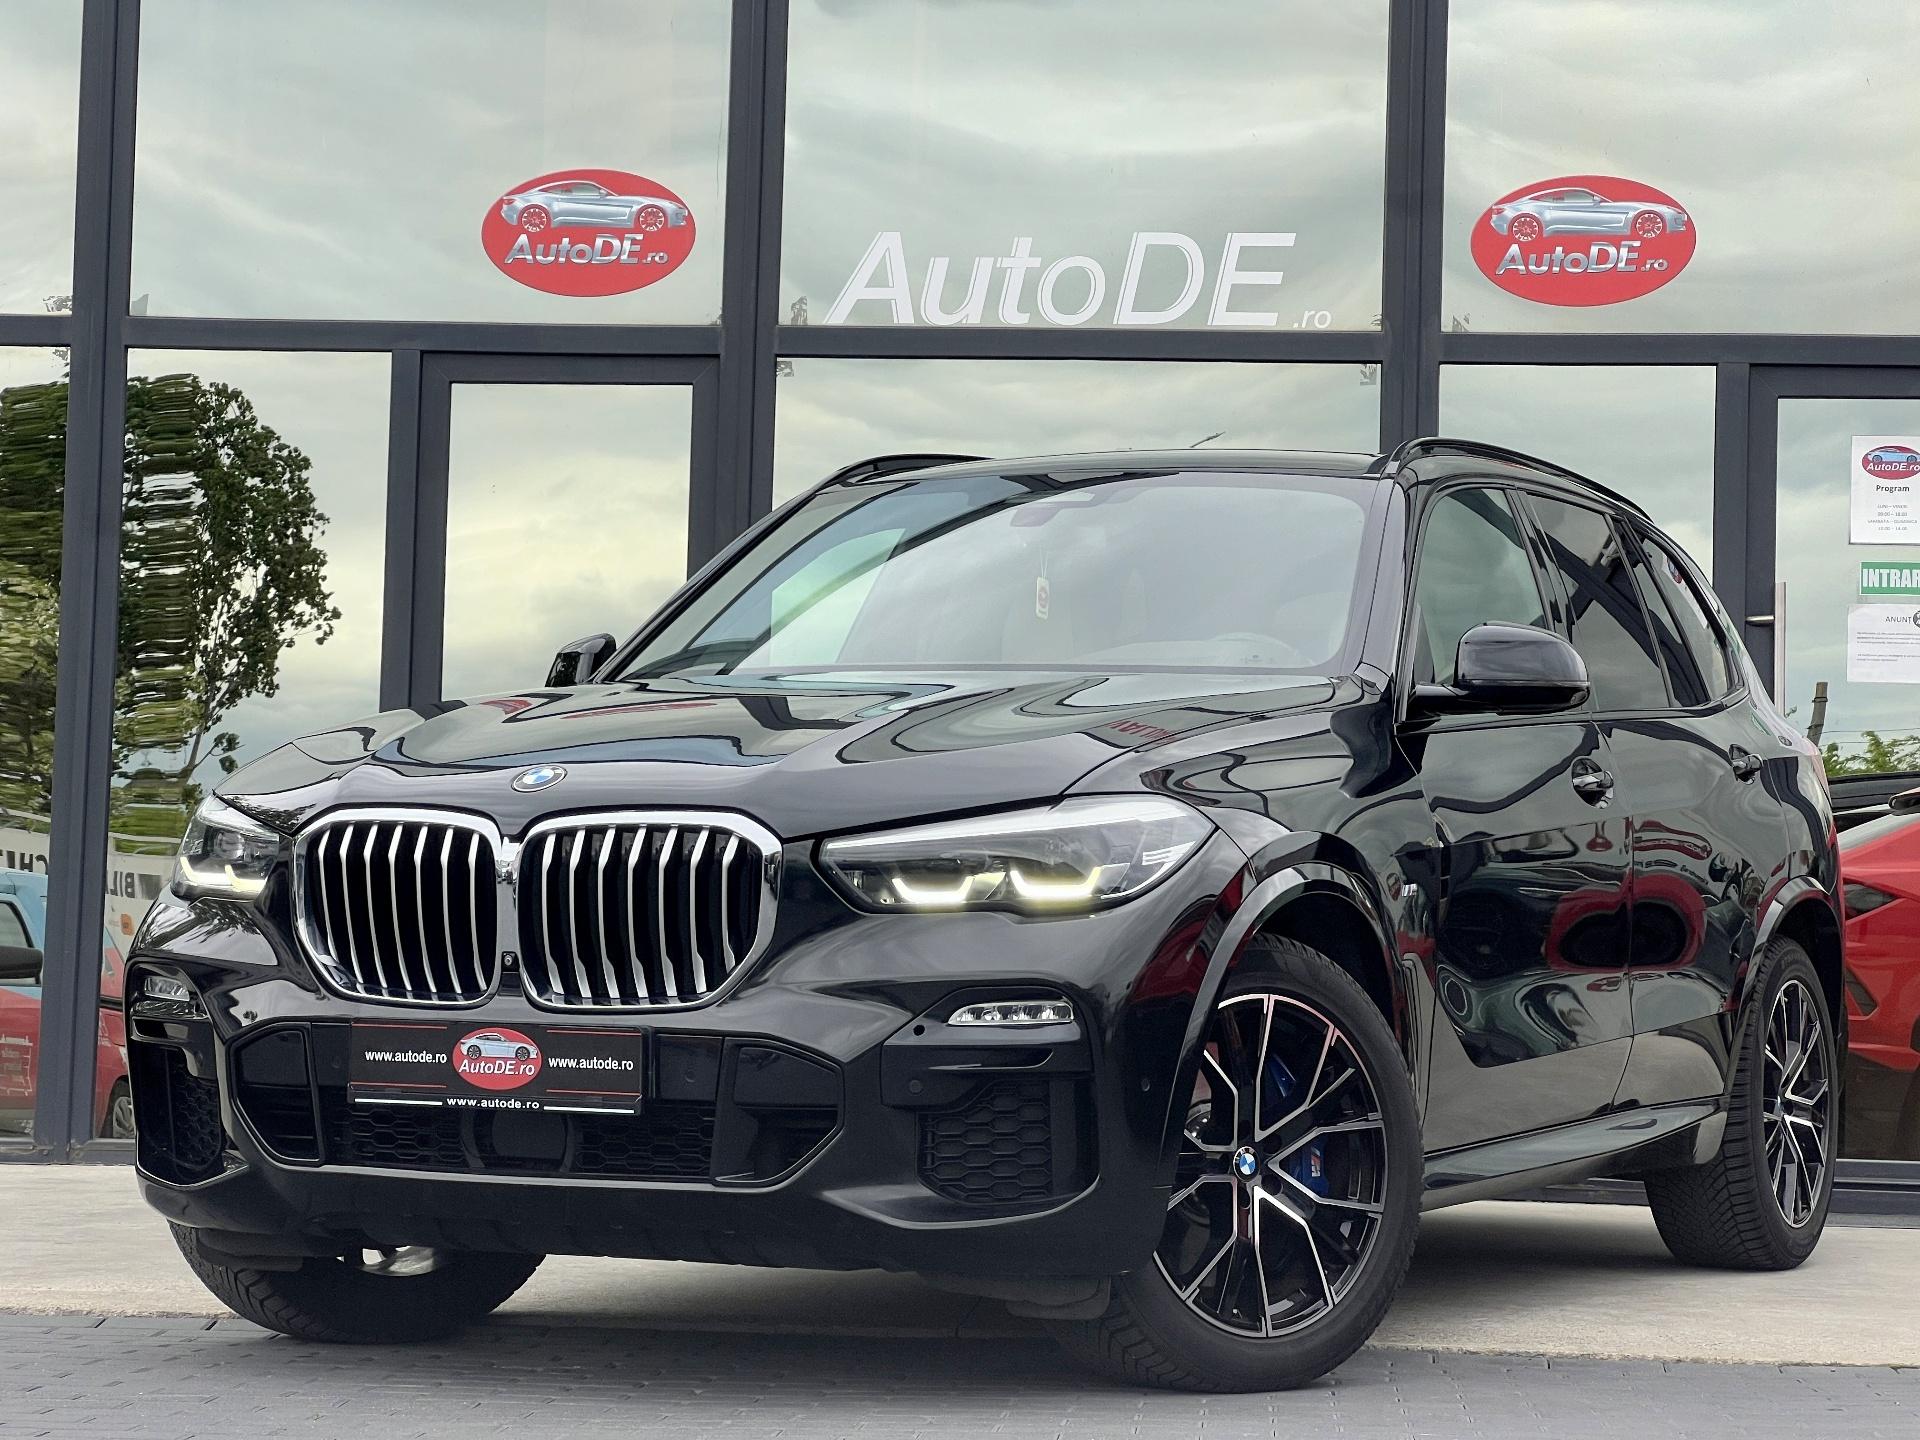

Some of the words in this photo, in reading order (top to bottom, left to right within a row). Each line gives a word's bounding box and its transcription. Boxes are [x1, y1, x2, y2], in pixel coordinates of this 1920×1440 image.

[1866, 462, 1920, 471] AutoDE.ro
[1876, 484, 1910, 494] Program
[365, 1050, 447, 1064] www.autode.ro
[548, 1056, 634, 1071] www.autode.ro
[458, 1059, 535, 1076] AutoDE.ro
[446, 1097, 540, 1110] www.autode.ro
